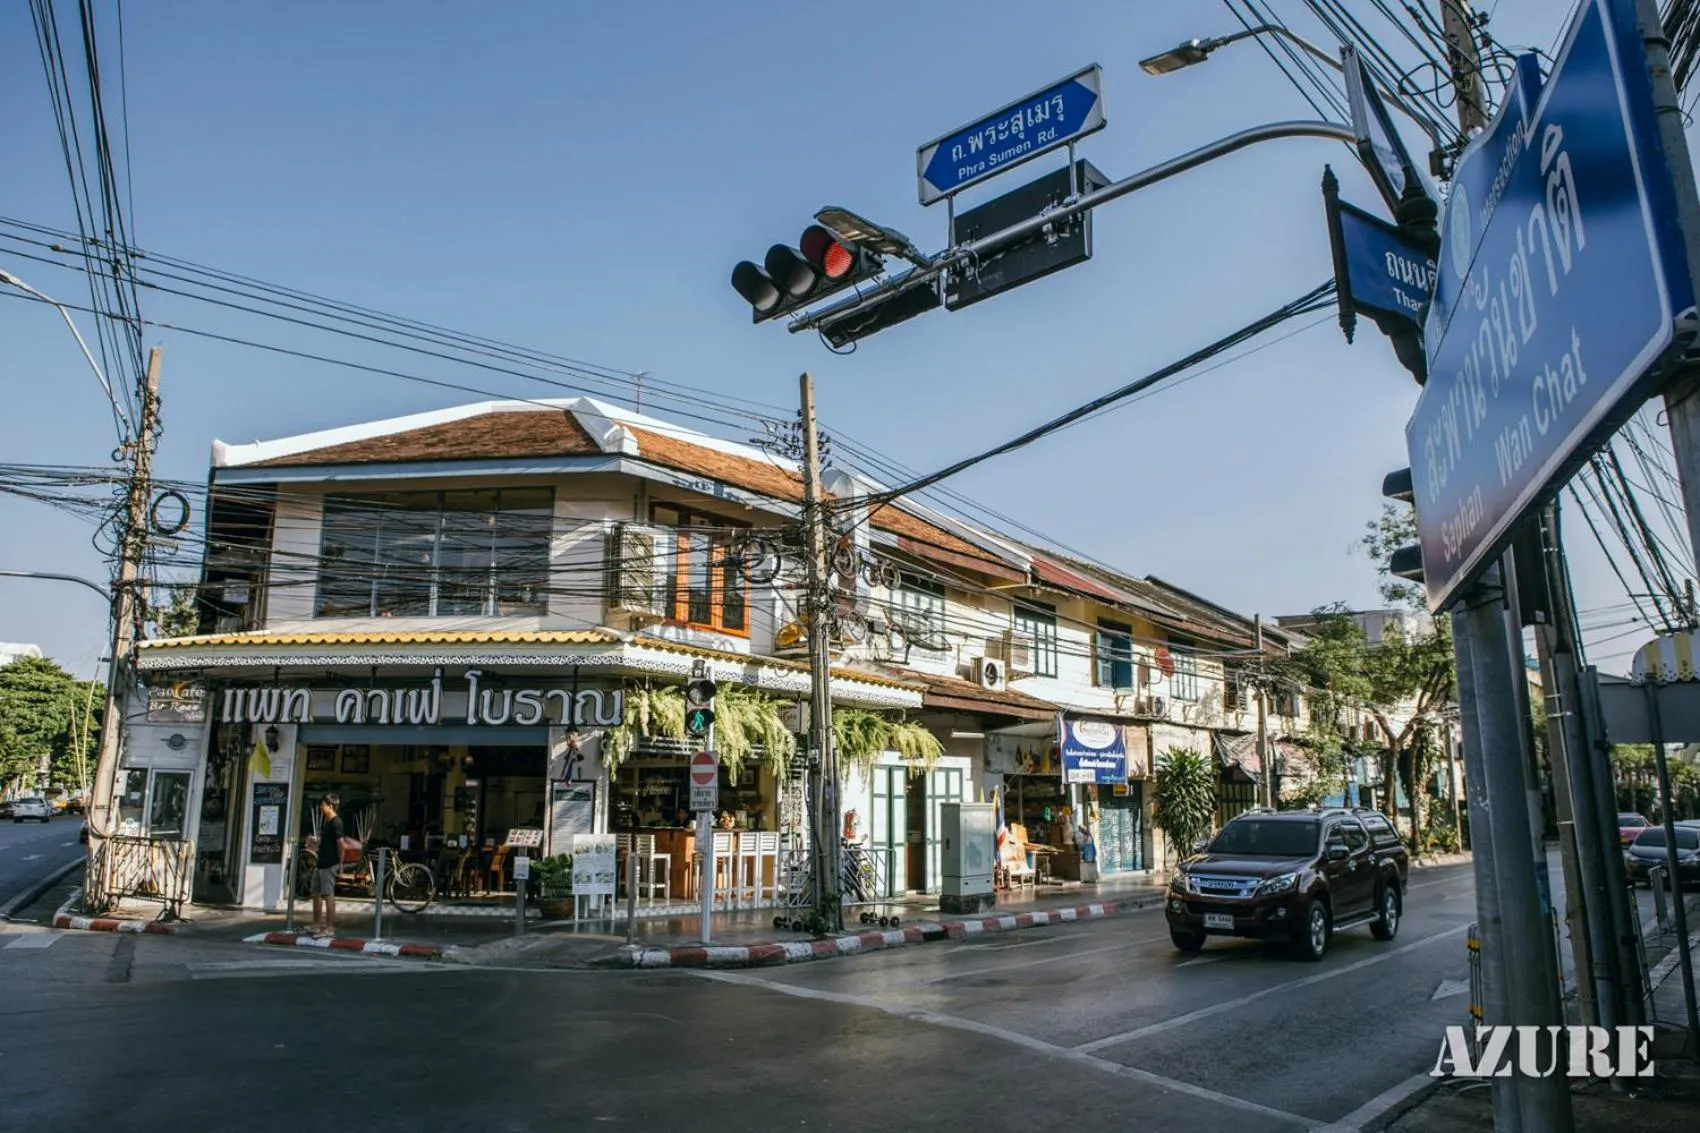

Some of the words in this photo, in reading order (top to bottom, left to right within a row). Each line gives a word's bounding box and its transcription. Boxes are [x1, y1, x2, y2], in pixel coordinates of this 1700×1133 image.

[958, 161, 986, 180] Phra
[988, 141, 1032, 166] Sumen
[1037, 127, 1058, 144] Rd.
[1441, 484, 1485, 563] Saphan
[1494, 414, 1533, 487] Wan
[1533, 325, 1588, 436] Chat
[222, 687, 311, 723] แพท
[335, 668, 443, 724] คาเฟ่
[464, 668, 625, 726] โบราณ
